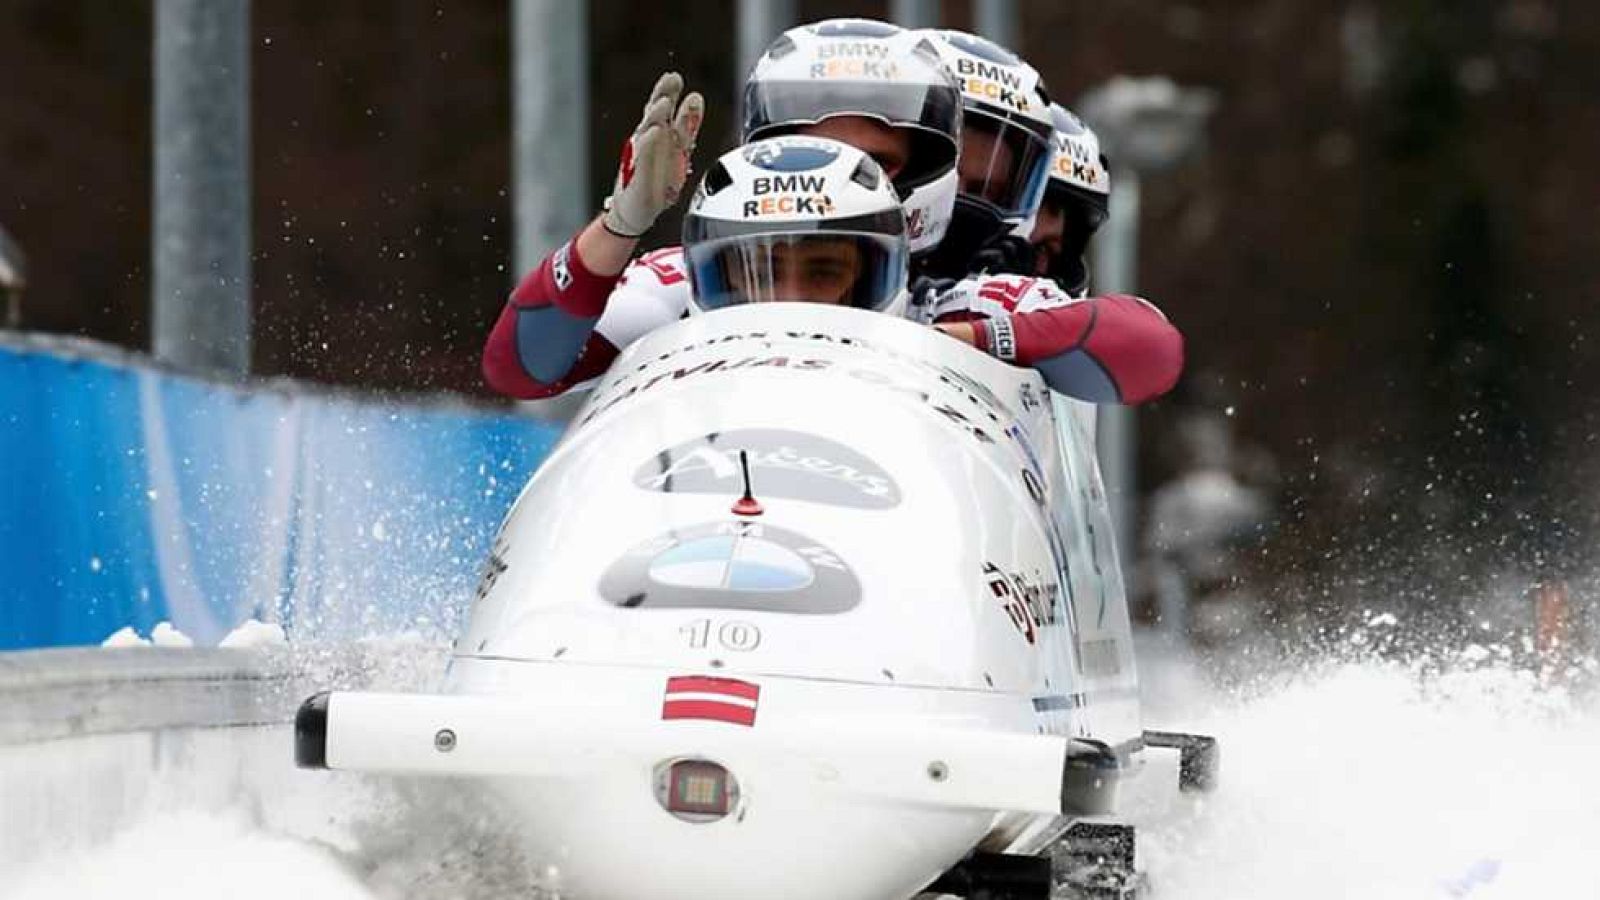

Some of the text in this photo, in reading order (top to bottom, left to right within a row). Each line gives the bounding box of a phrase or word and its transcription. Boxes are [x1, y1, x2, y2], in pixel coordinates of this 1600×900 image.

[817, 43, 889, 59] BMW
[957, 58, 1021, 90] BMW
[1056, 138, 1091, 162] MW
[753, 175, 825, 195] BMW
[679, 620, 761, 652] 10
